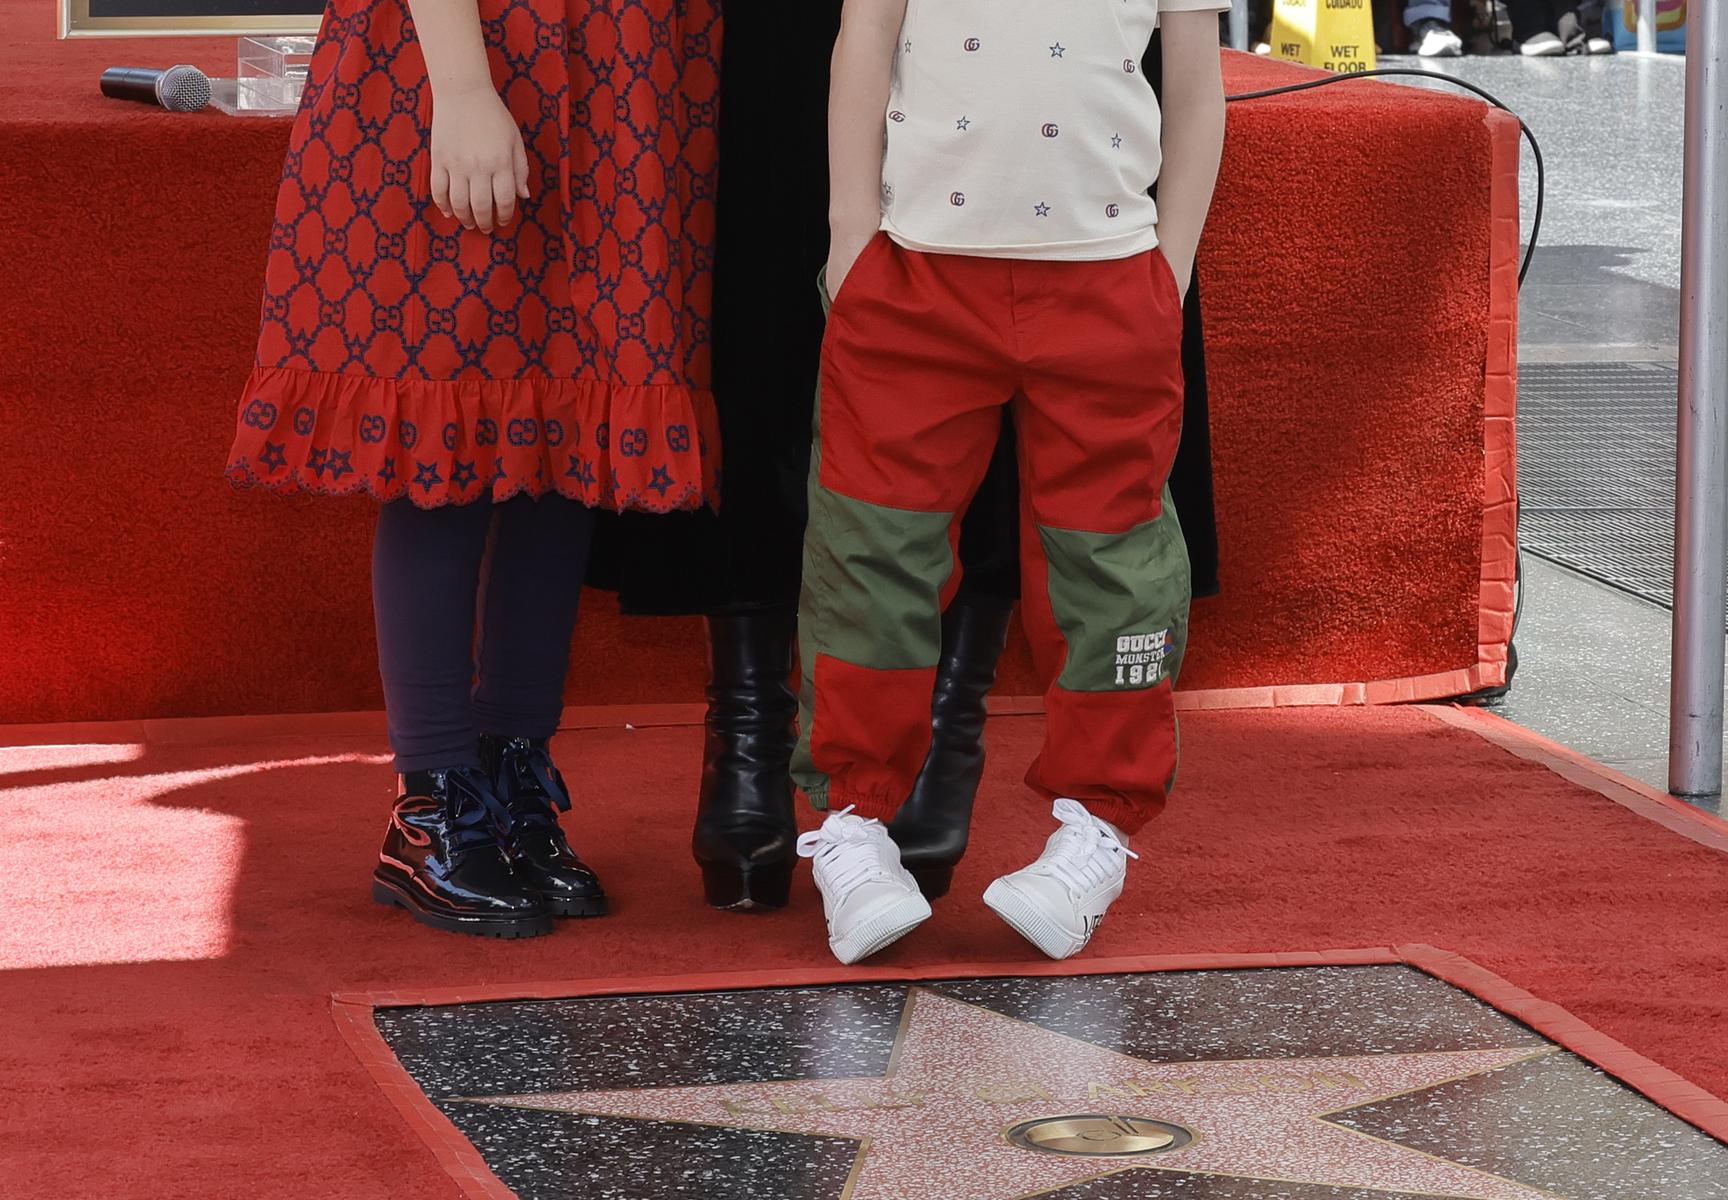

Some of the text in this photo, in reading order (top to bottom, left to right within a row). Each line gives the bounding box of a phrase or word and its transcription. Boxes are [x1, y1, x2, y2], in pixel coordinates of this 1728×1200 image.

[1281, 43, 1301, 57] WET
[1330, 45, 1360, 58] WET
[1116, 629, 1168, 653] GUCCI
